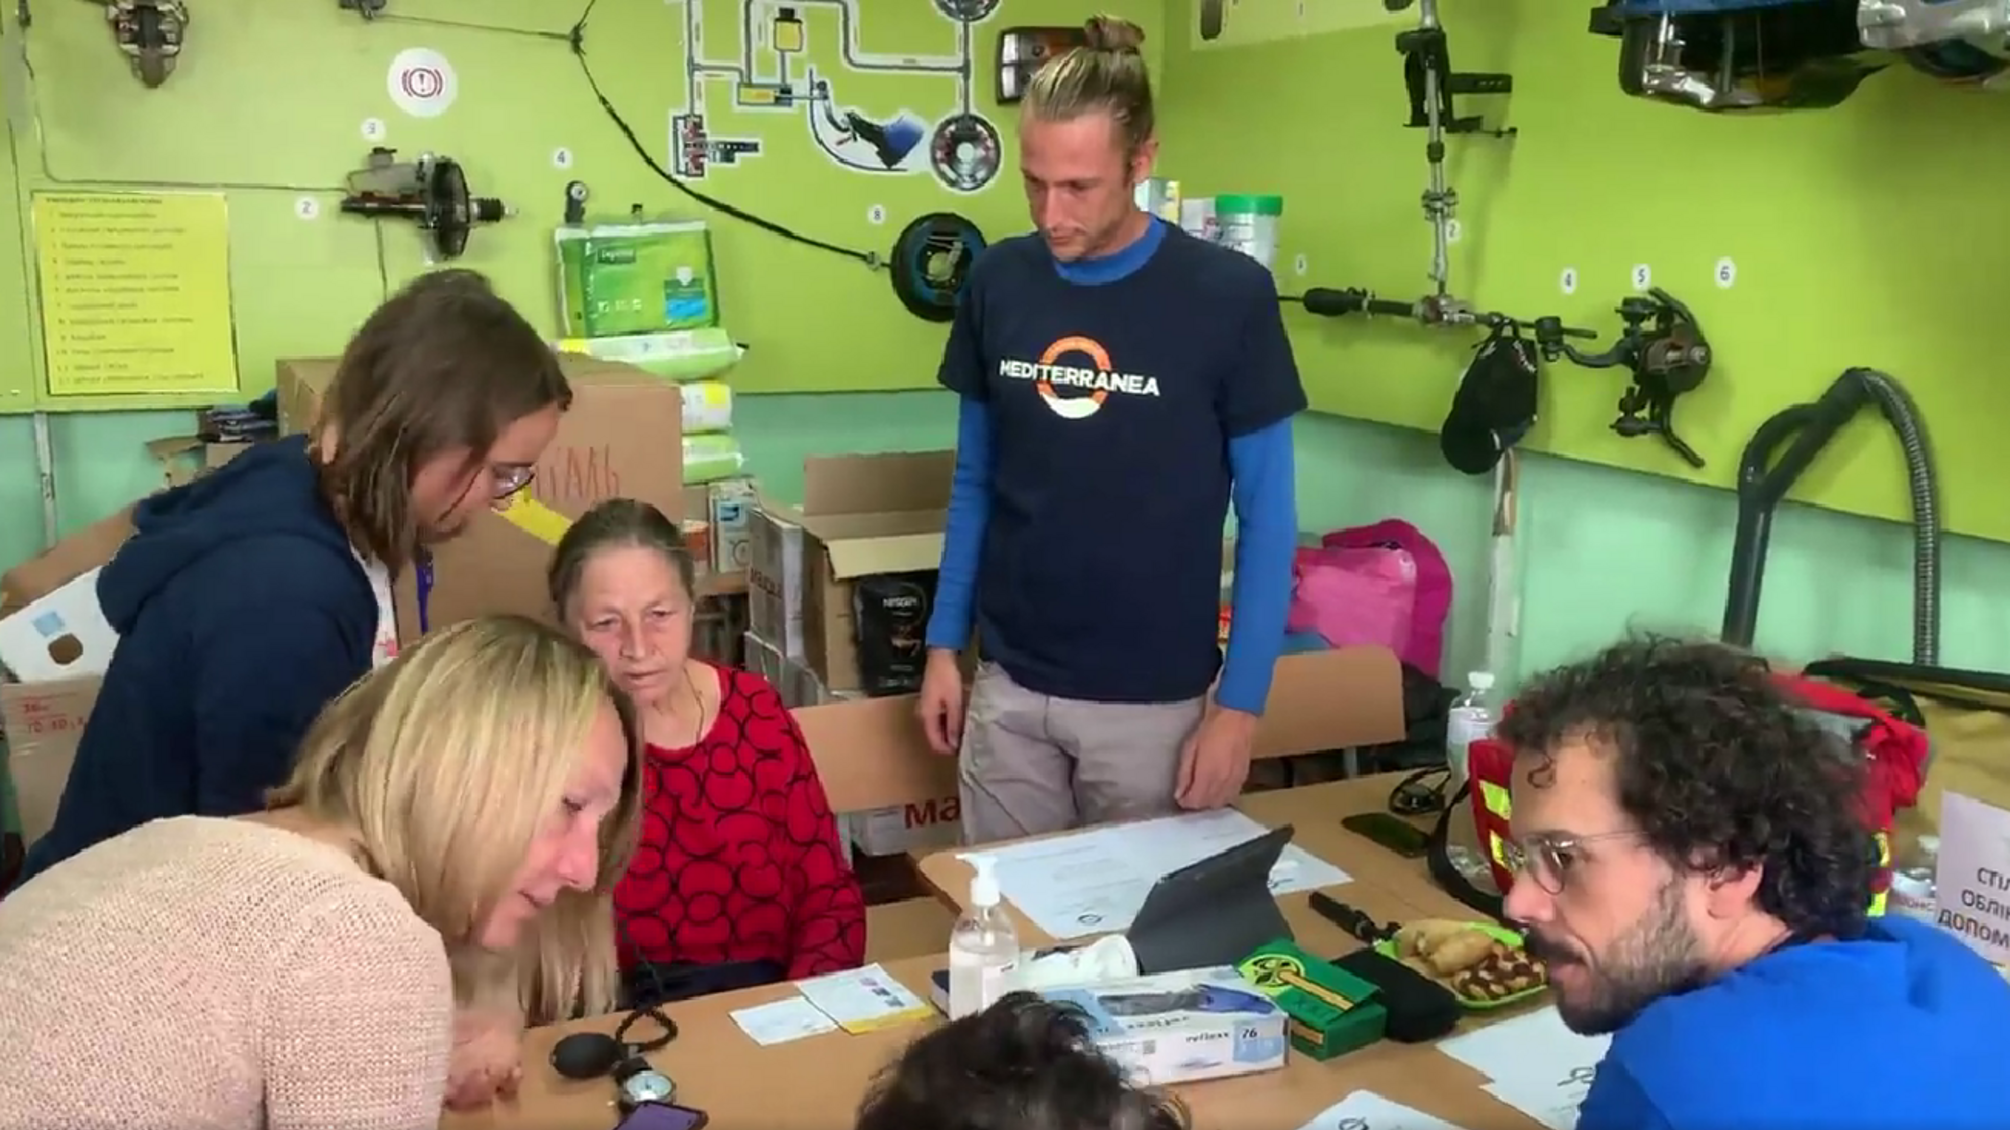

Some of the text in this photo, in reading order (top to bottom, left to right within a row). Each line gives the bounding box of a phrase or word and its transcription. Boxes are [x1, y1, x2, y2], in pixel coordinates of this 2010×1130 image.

[301, 200, 312, 215] 2
[1719, 264, 1731, 282] 6
[1000, 359, 1161, 397] MEDITERRANEA
[1241, 1027, 1259, 1040] 76
